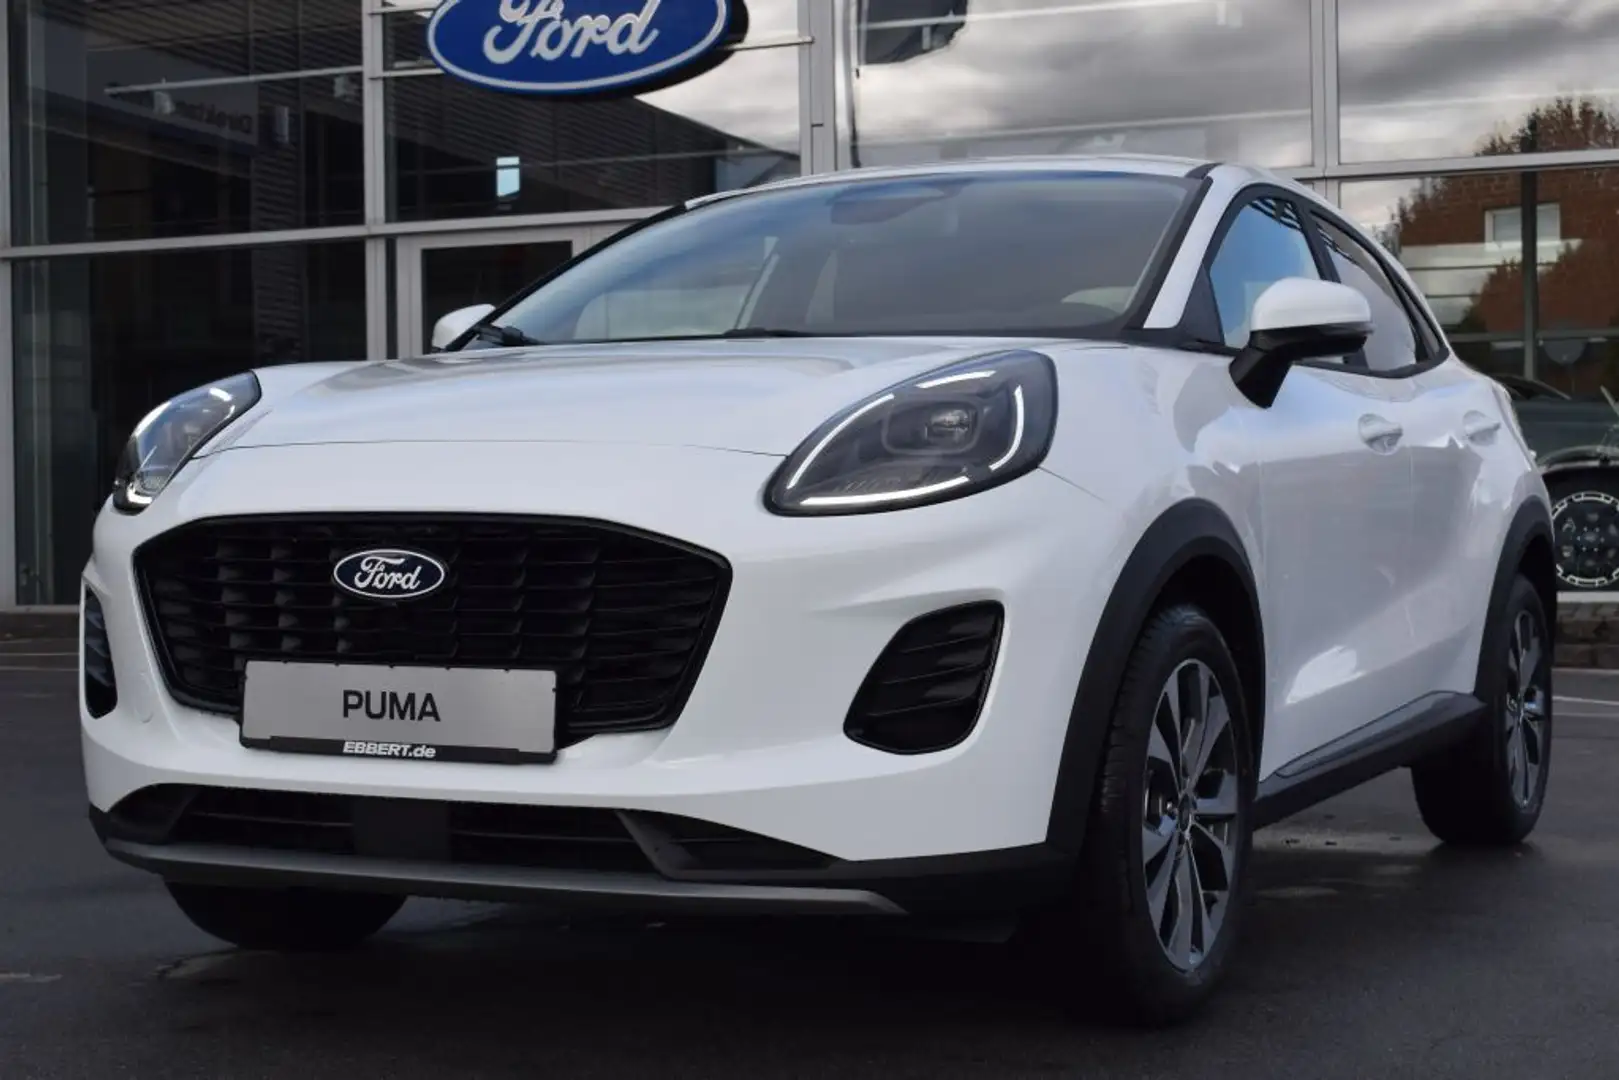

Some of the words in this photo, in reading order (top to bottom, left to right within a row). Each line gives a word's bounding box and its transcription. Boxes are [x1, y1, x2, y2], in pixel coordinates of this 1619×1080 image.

[483, 0, 660, 64] Ford
[354, 556, 422, 590] Ford
[342, 689, 441, 722] PUMA
[342, 741, 436, 758] EBBERT.de
